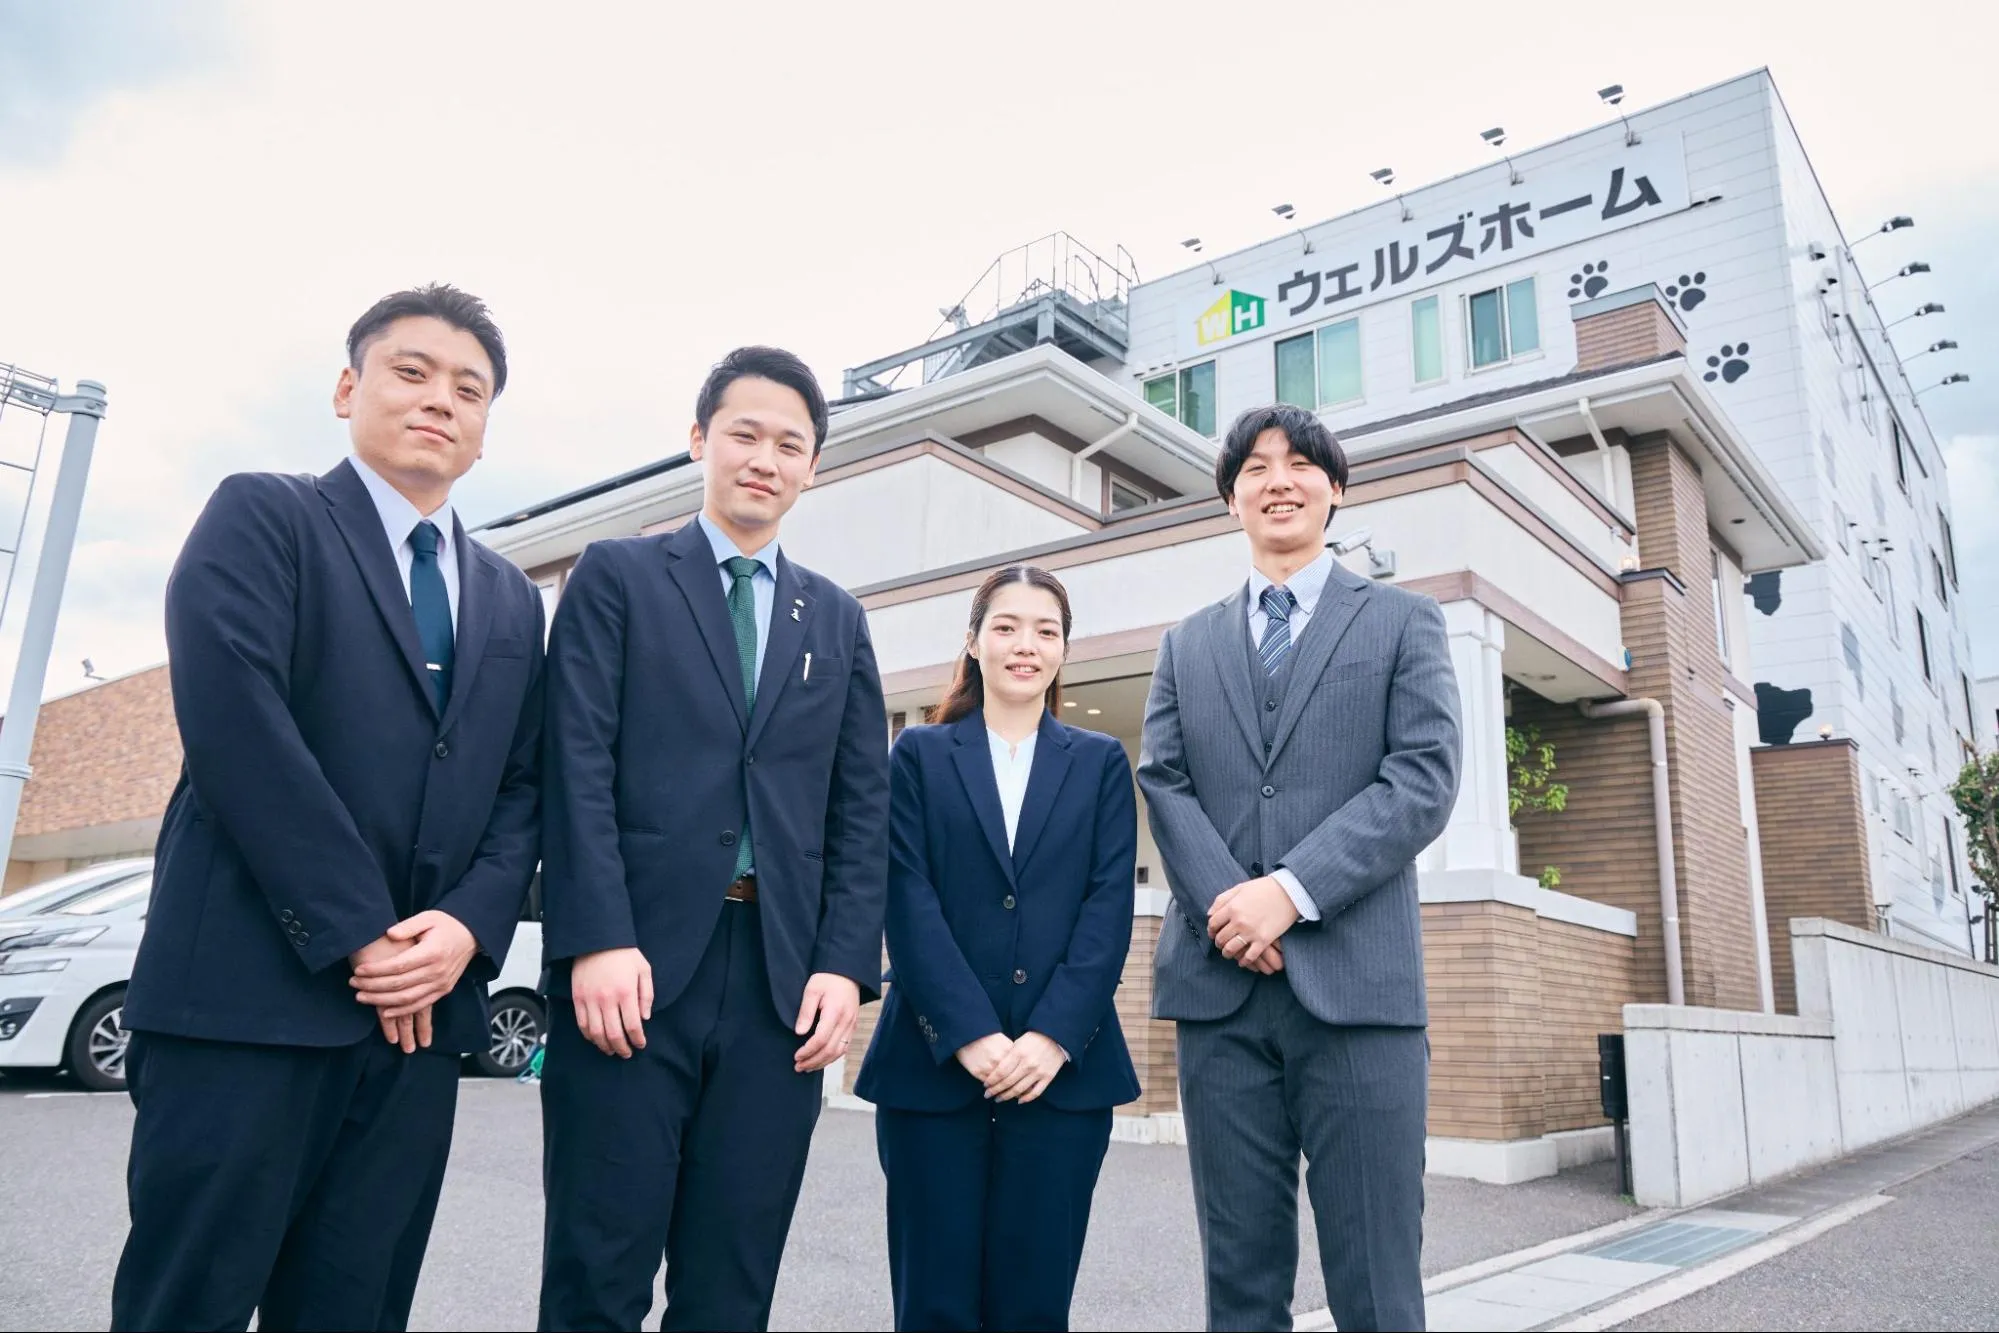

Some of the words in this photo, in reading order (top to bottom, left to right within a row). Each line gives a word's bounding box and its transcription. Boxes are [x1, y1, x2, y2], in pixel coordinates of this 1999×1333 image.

[1278, 166, 1661, 316] ウェルズホーム
[1202, 300, 1258, 341] WH
